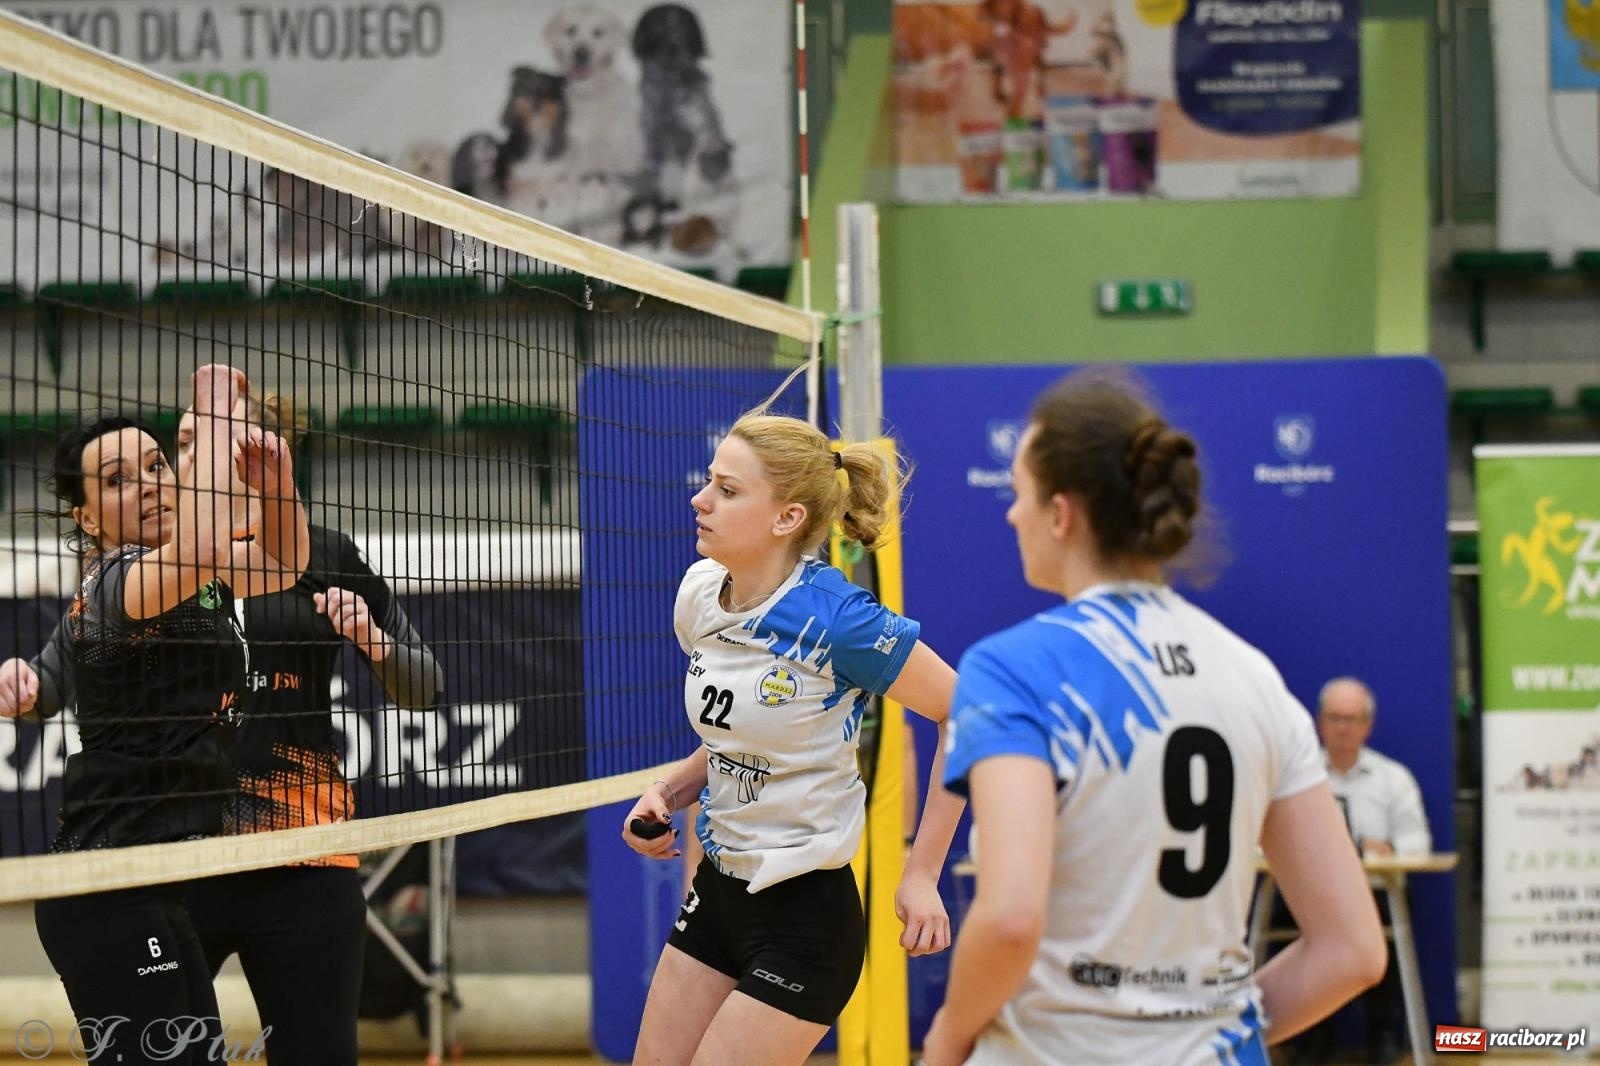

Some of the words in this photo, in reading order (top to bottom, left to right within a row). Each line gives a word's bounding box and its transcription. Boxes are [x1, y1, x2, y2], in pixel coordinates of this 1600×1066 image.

[137, 8, 223, 63] DLA
[238, 5, 444, 60] TWOJEGO
[1155, 645, 1195, 677] LIS
[700, 685, 734, 731] 22
[1157, 725, 1235, 899] 9
[147, 937, 162, 958] 6
[137, 960, 179, 976] DAMONS
[752, 968, 804, 993] COLO
